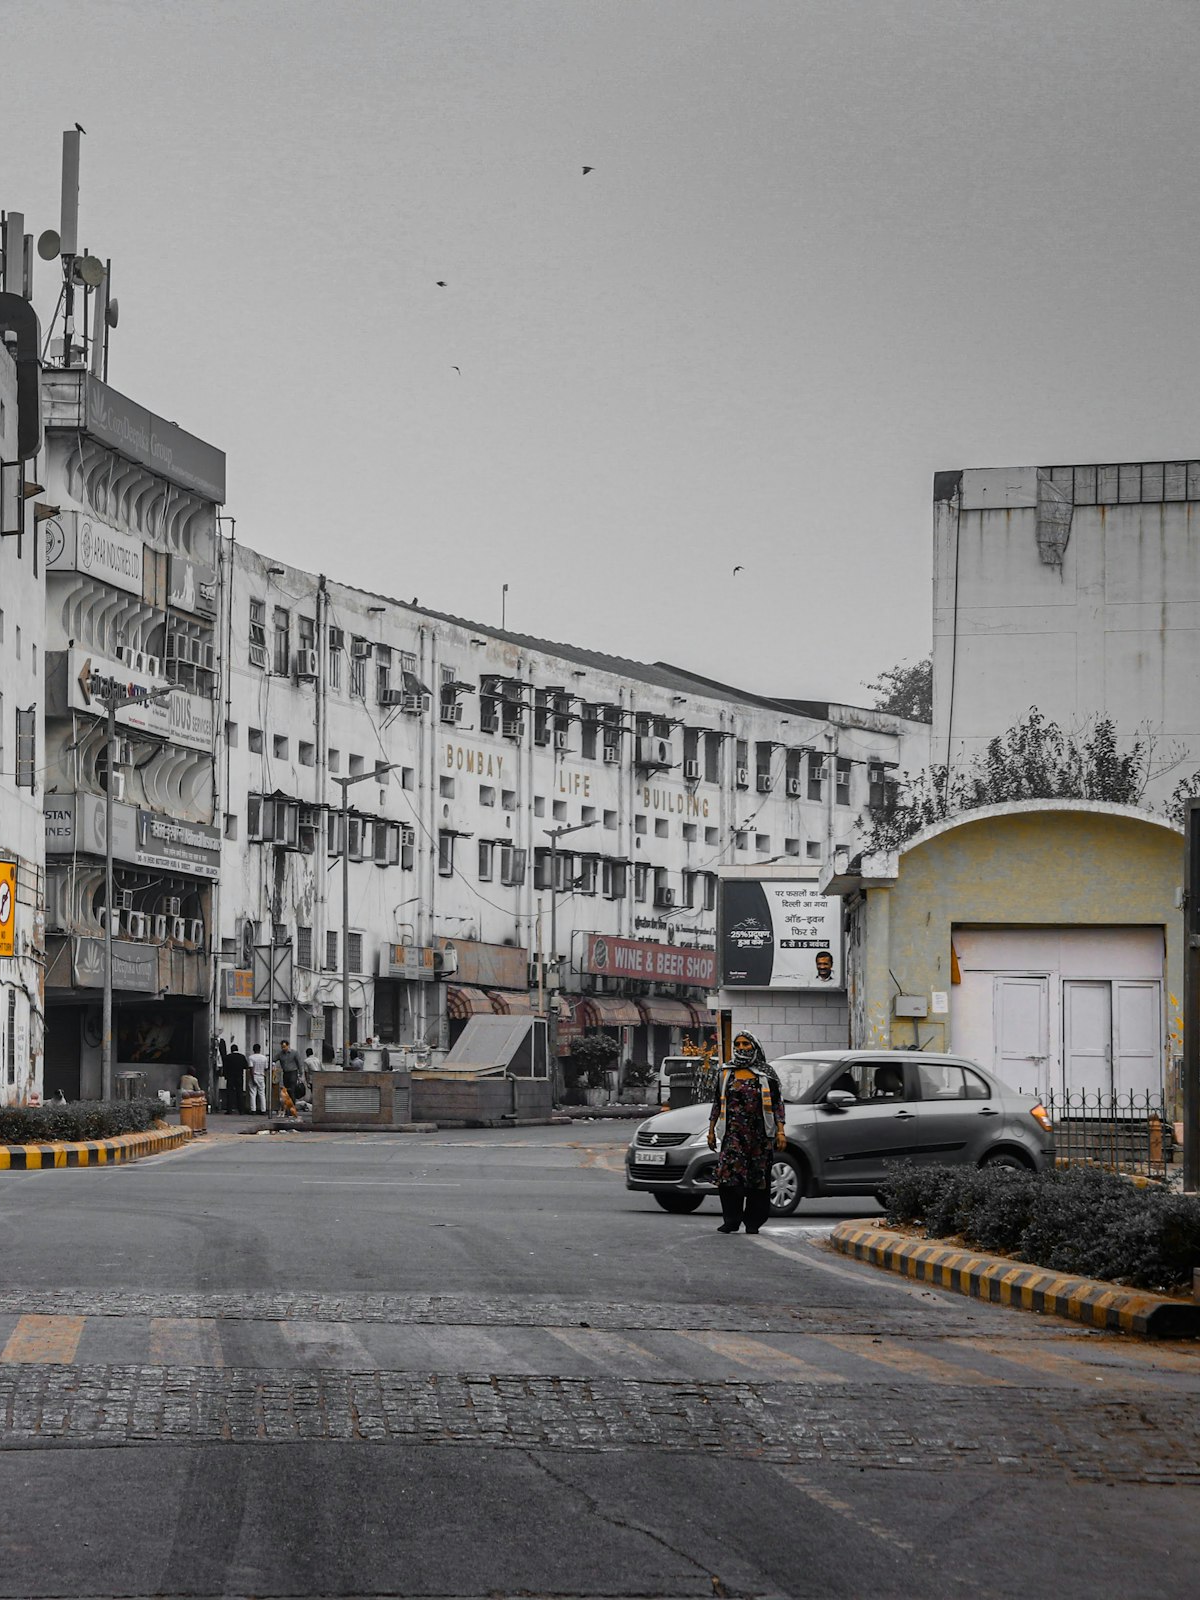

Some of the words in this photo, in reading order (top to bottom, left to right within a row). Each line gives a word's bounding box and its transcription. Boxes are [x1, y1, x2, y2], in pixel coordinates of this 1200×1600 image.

[150, 433, 173, 470] Group
[191, 715, 212, 736] SERVICES
[446, 743, 503, 779] BOMBAY
[559, 770, 590, 798] LIFE
[643, 786, 709, 818] BUILDING
[43, 810, 72, 820] STAN
[782, 899, 801, 908] दिल्ली
[791, 926, 807, 936] फिर
[810, 926, 818, 936] से
[788, 940, 795, 948] से
[614, 946, 643, 971] WINE
[645, 951, 653, 973] &
[656, 952, 684, 976] BEER
[686, 957, 714, 979] SHOP
